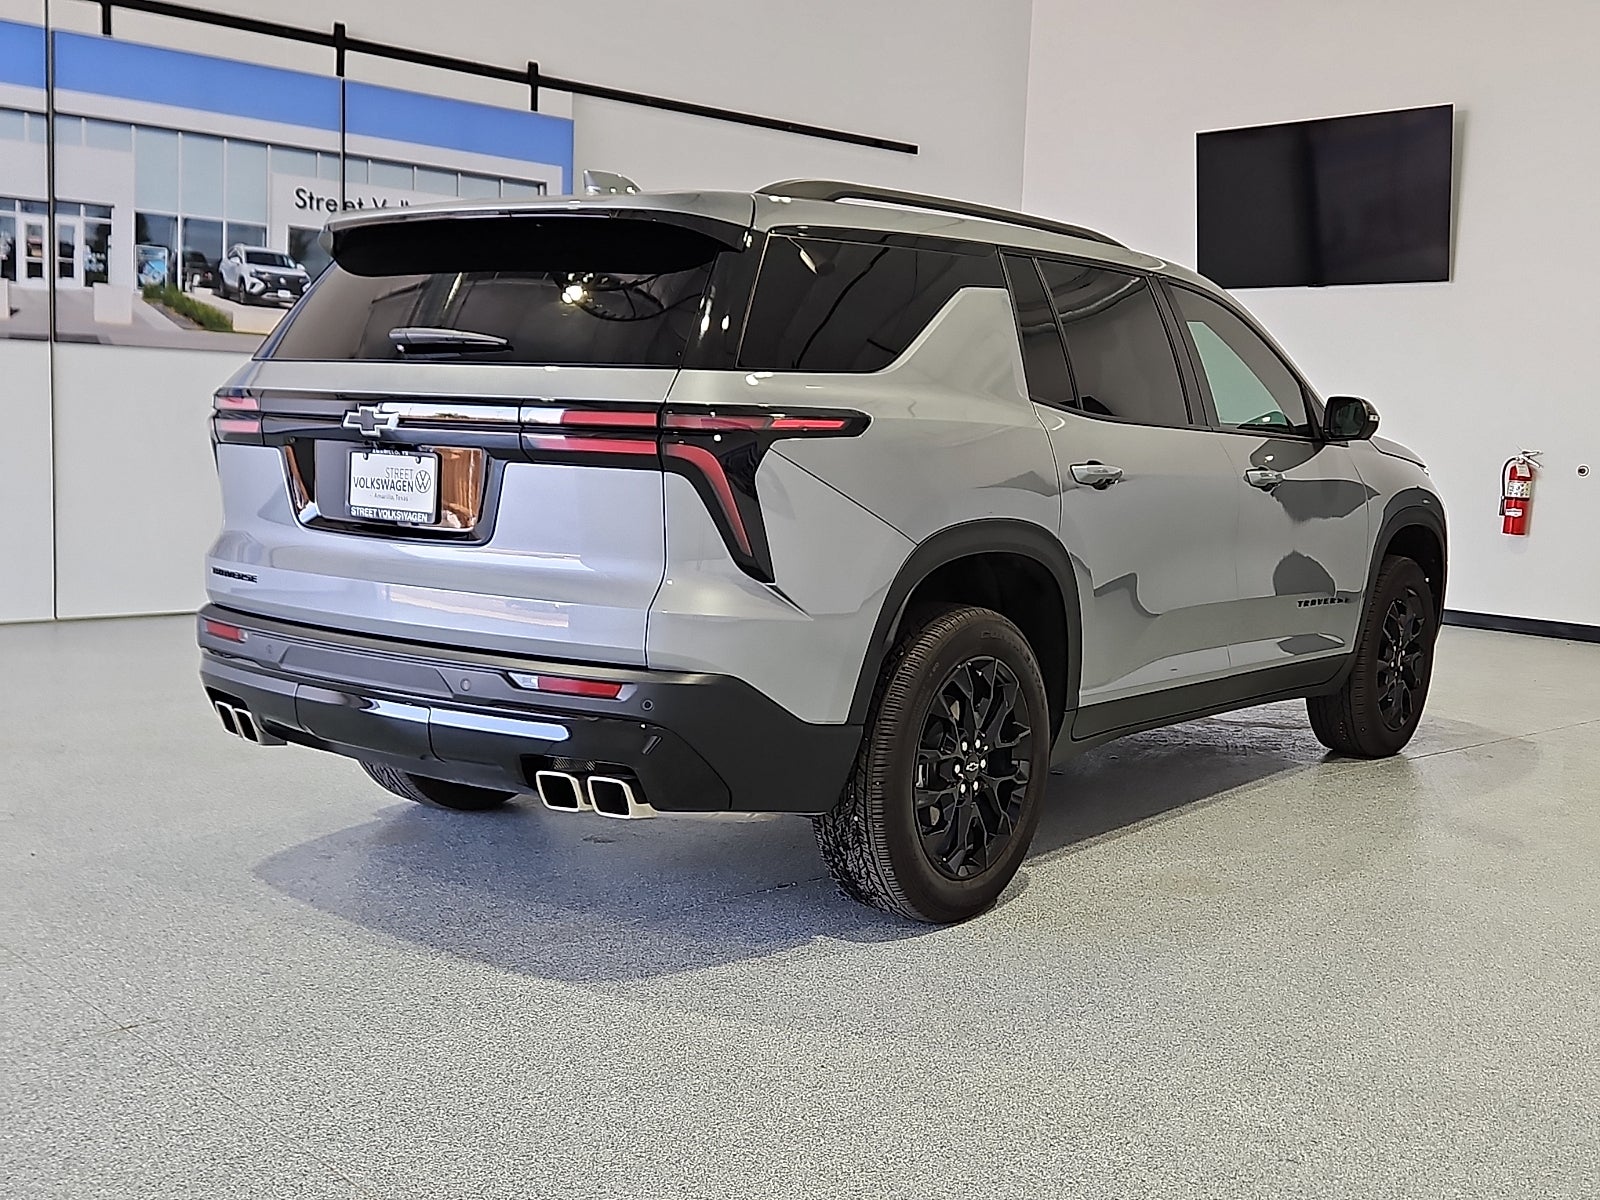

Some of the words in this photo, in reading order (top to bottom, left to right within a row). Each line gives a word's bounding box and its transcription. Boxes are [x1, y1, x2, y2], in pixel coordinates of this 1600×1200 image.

[294, 187, 364, 213] Street
[385, 467, 414, 480] STREET
[353, 476, 414, 493] VOLKSWAGEN
[350, 507, 377, 519] STREET
[378, 509, 428, 522] VOLKSWAGEN
